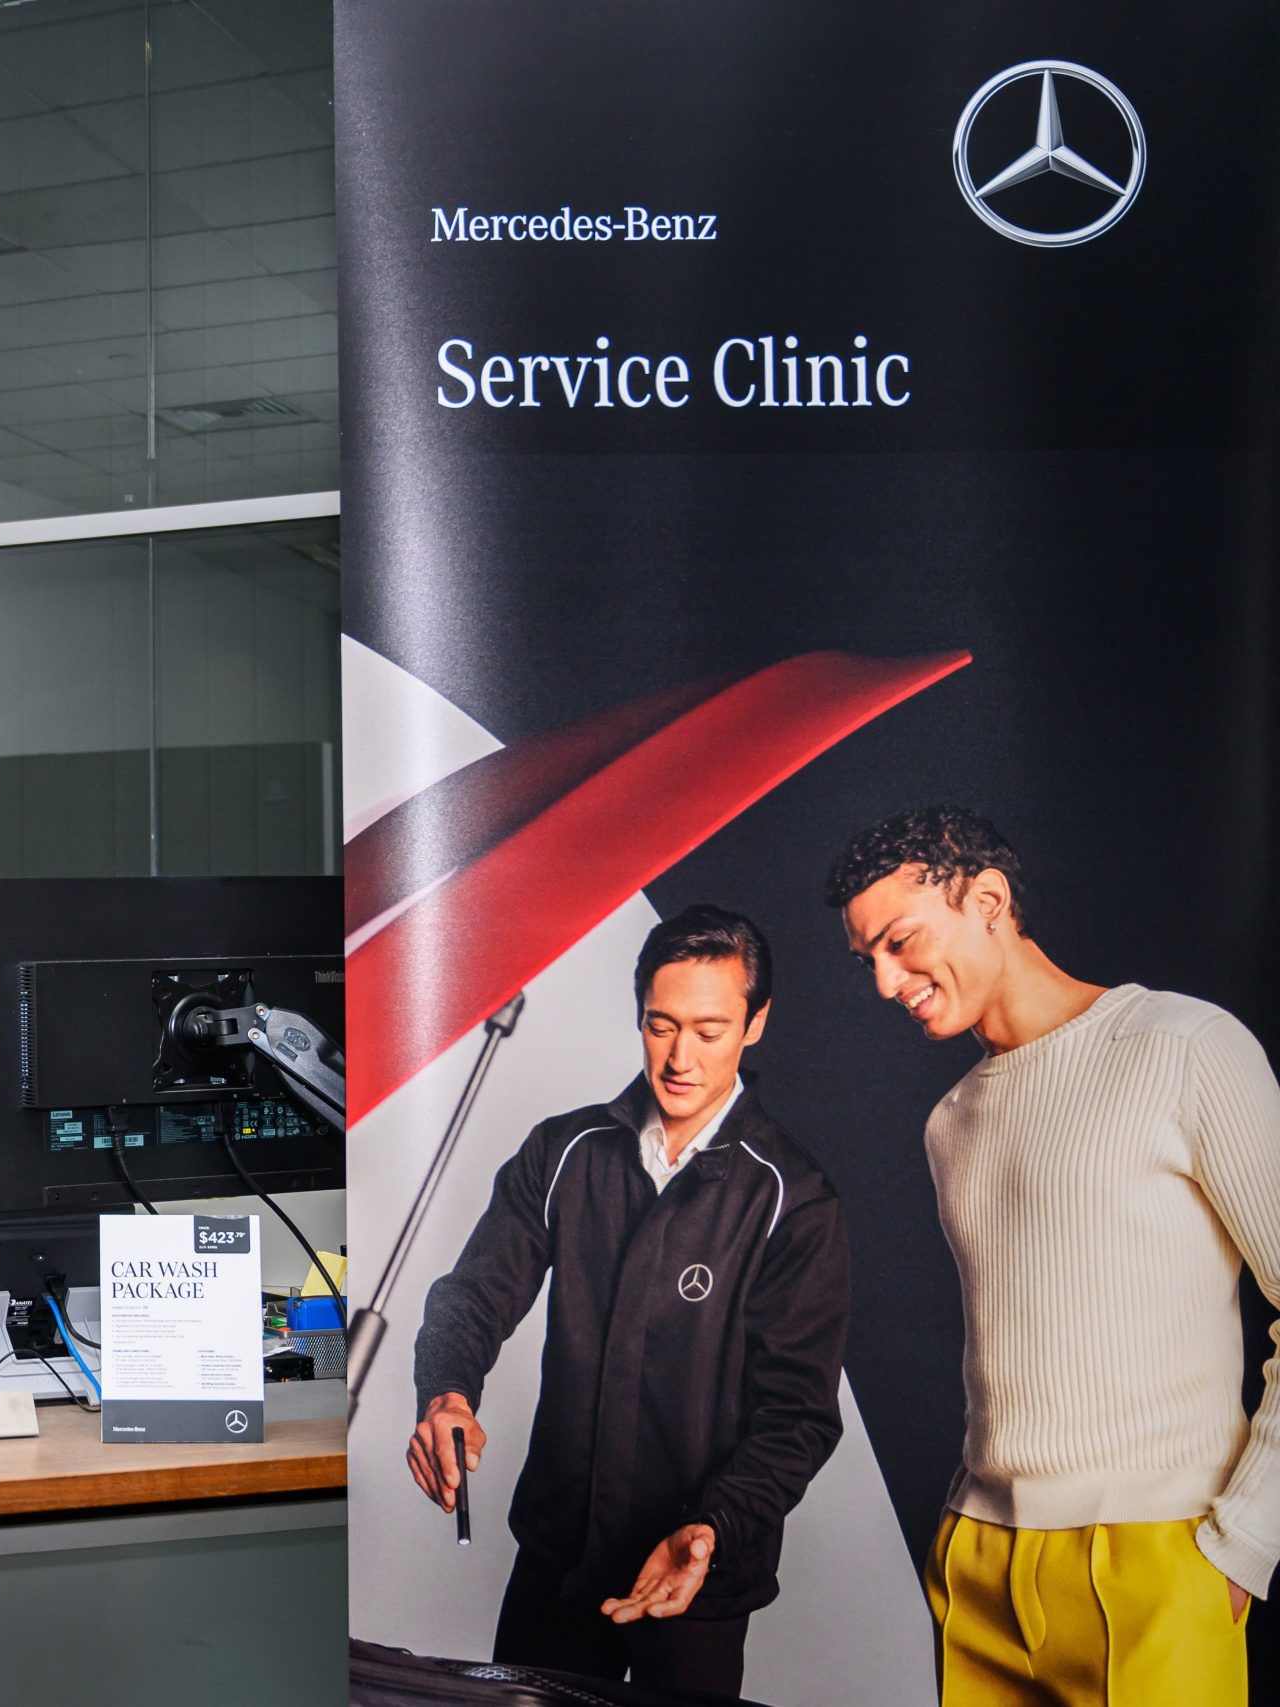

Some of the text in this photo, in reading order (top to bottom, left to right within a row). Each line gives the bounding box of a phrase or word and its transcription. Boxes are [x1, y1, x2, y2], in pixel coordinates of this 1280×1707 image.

[431, 207, 717, 242] Mercedes-Benz
[437, 335, 911, 408] Service Clinic
[111, 1261, 218, 1278] CAR WASH
[112, 1282, 204, 1299] PACKAGE
